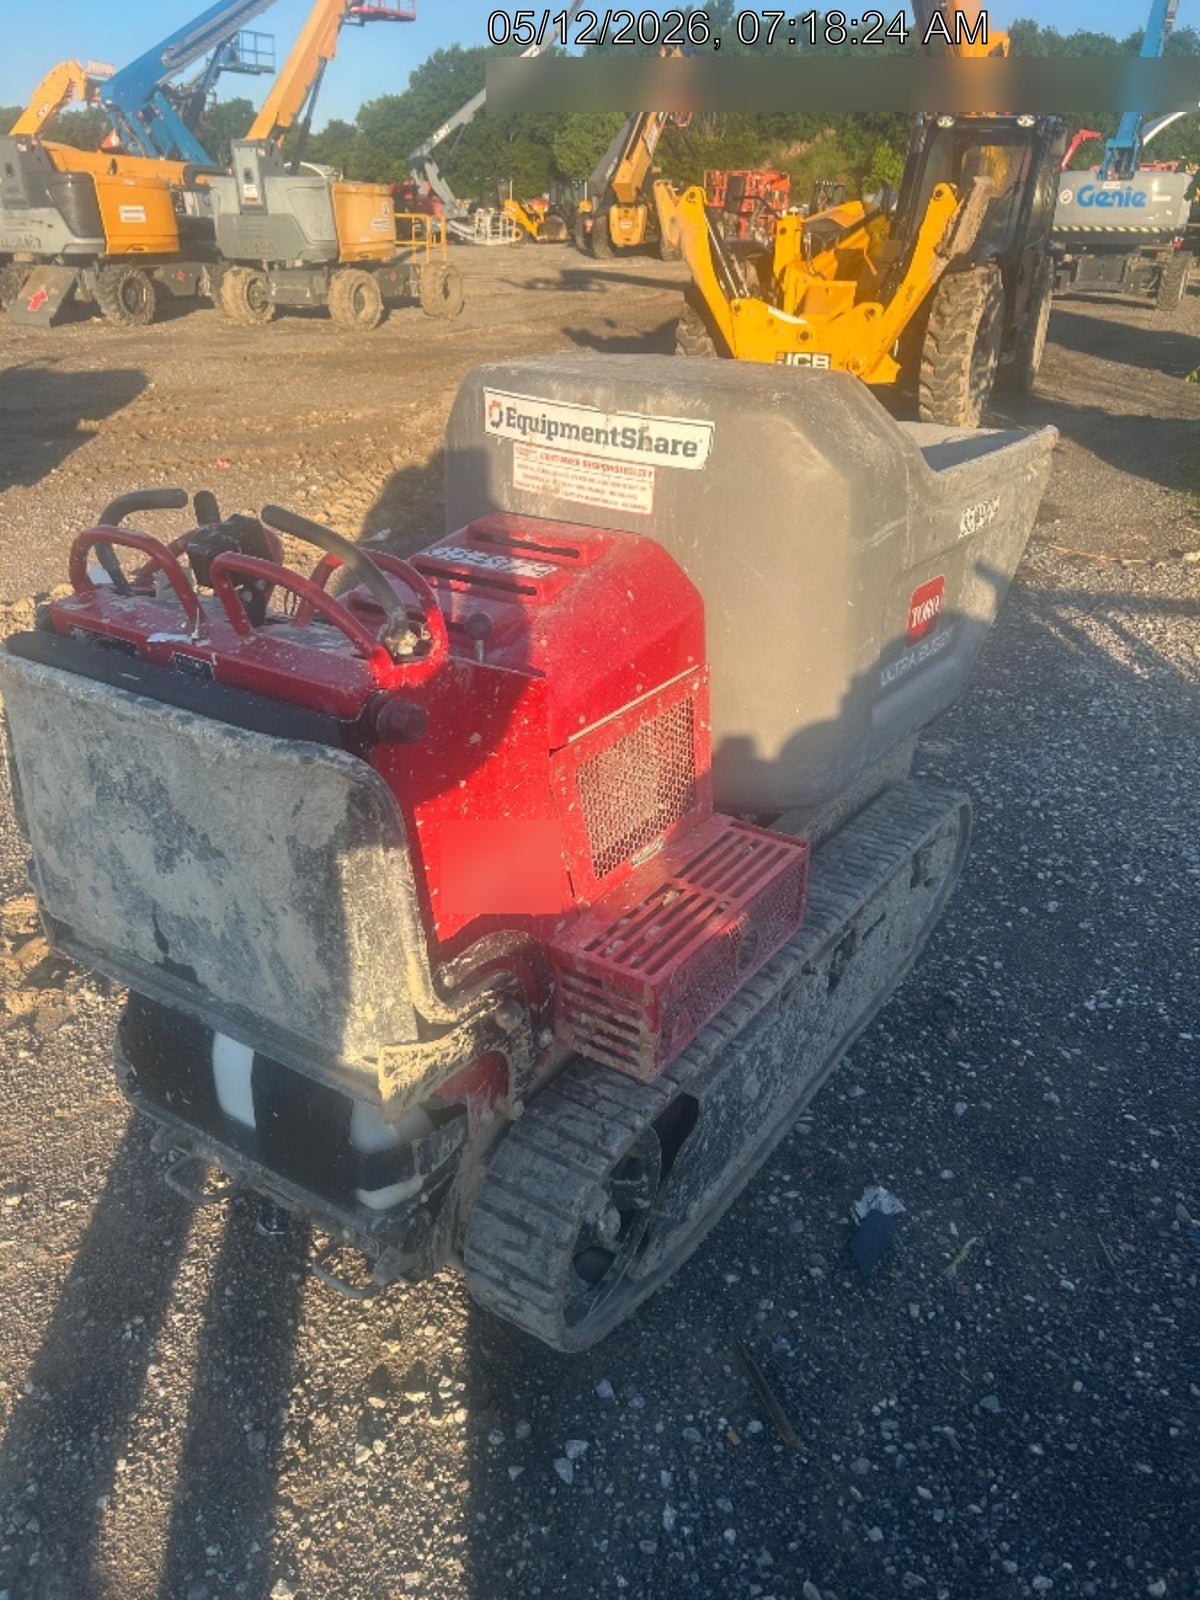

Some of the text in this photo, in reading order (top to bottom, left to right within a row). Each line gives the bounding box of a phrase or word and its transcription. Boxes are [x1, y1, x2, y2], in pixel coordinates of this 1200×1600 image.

[1076, 184, 1147, 208] Genie
[785, 352, 830, 369] JCB
[506, 406, 698, 458] EquipmentShare
